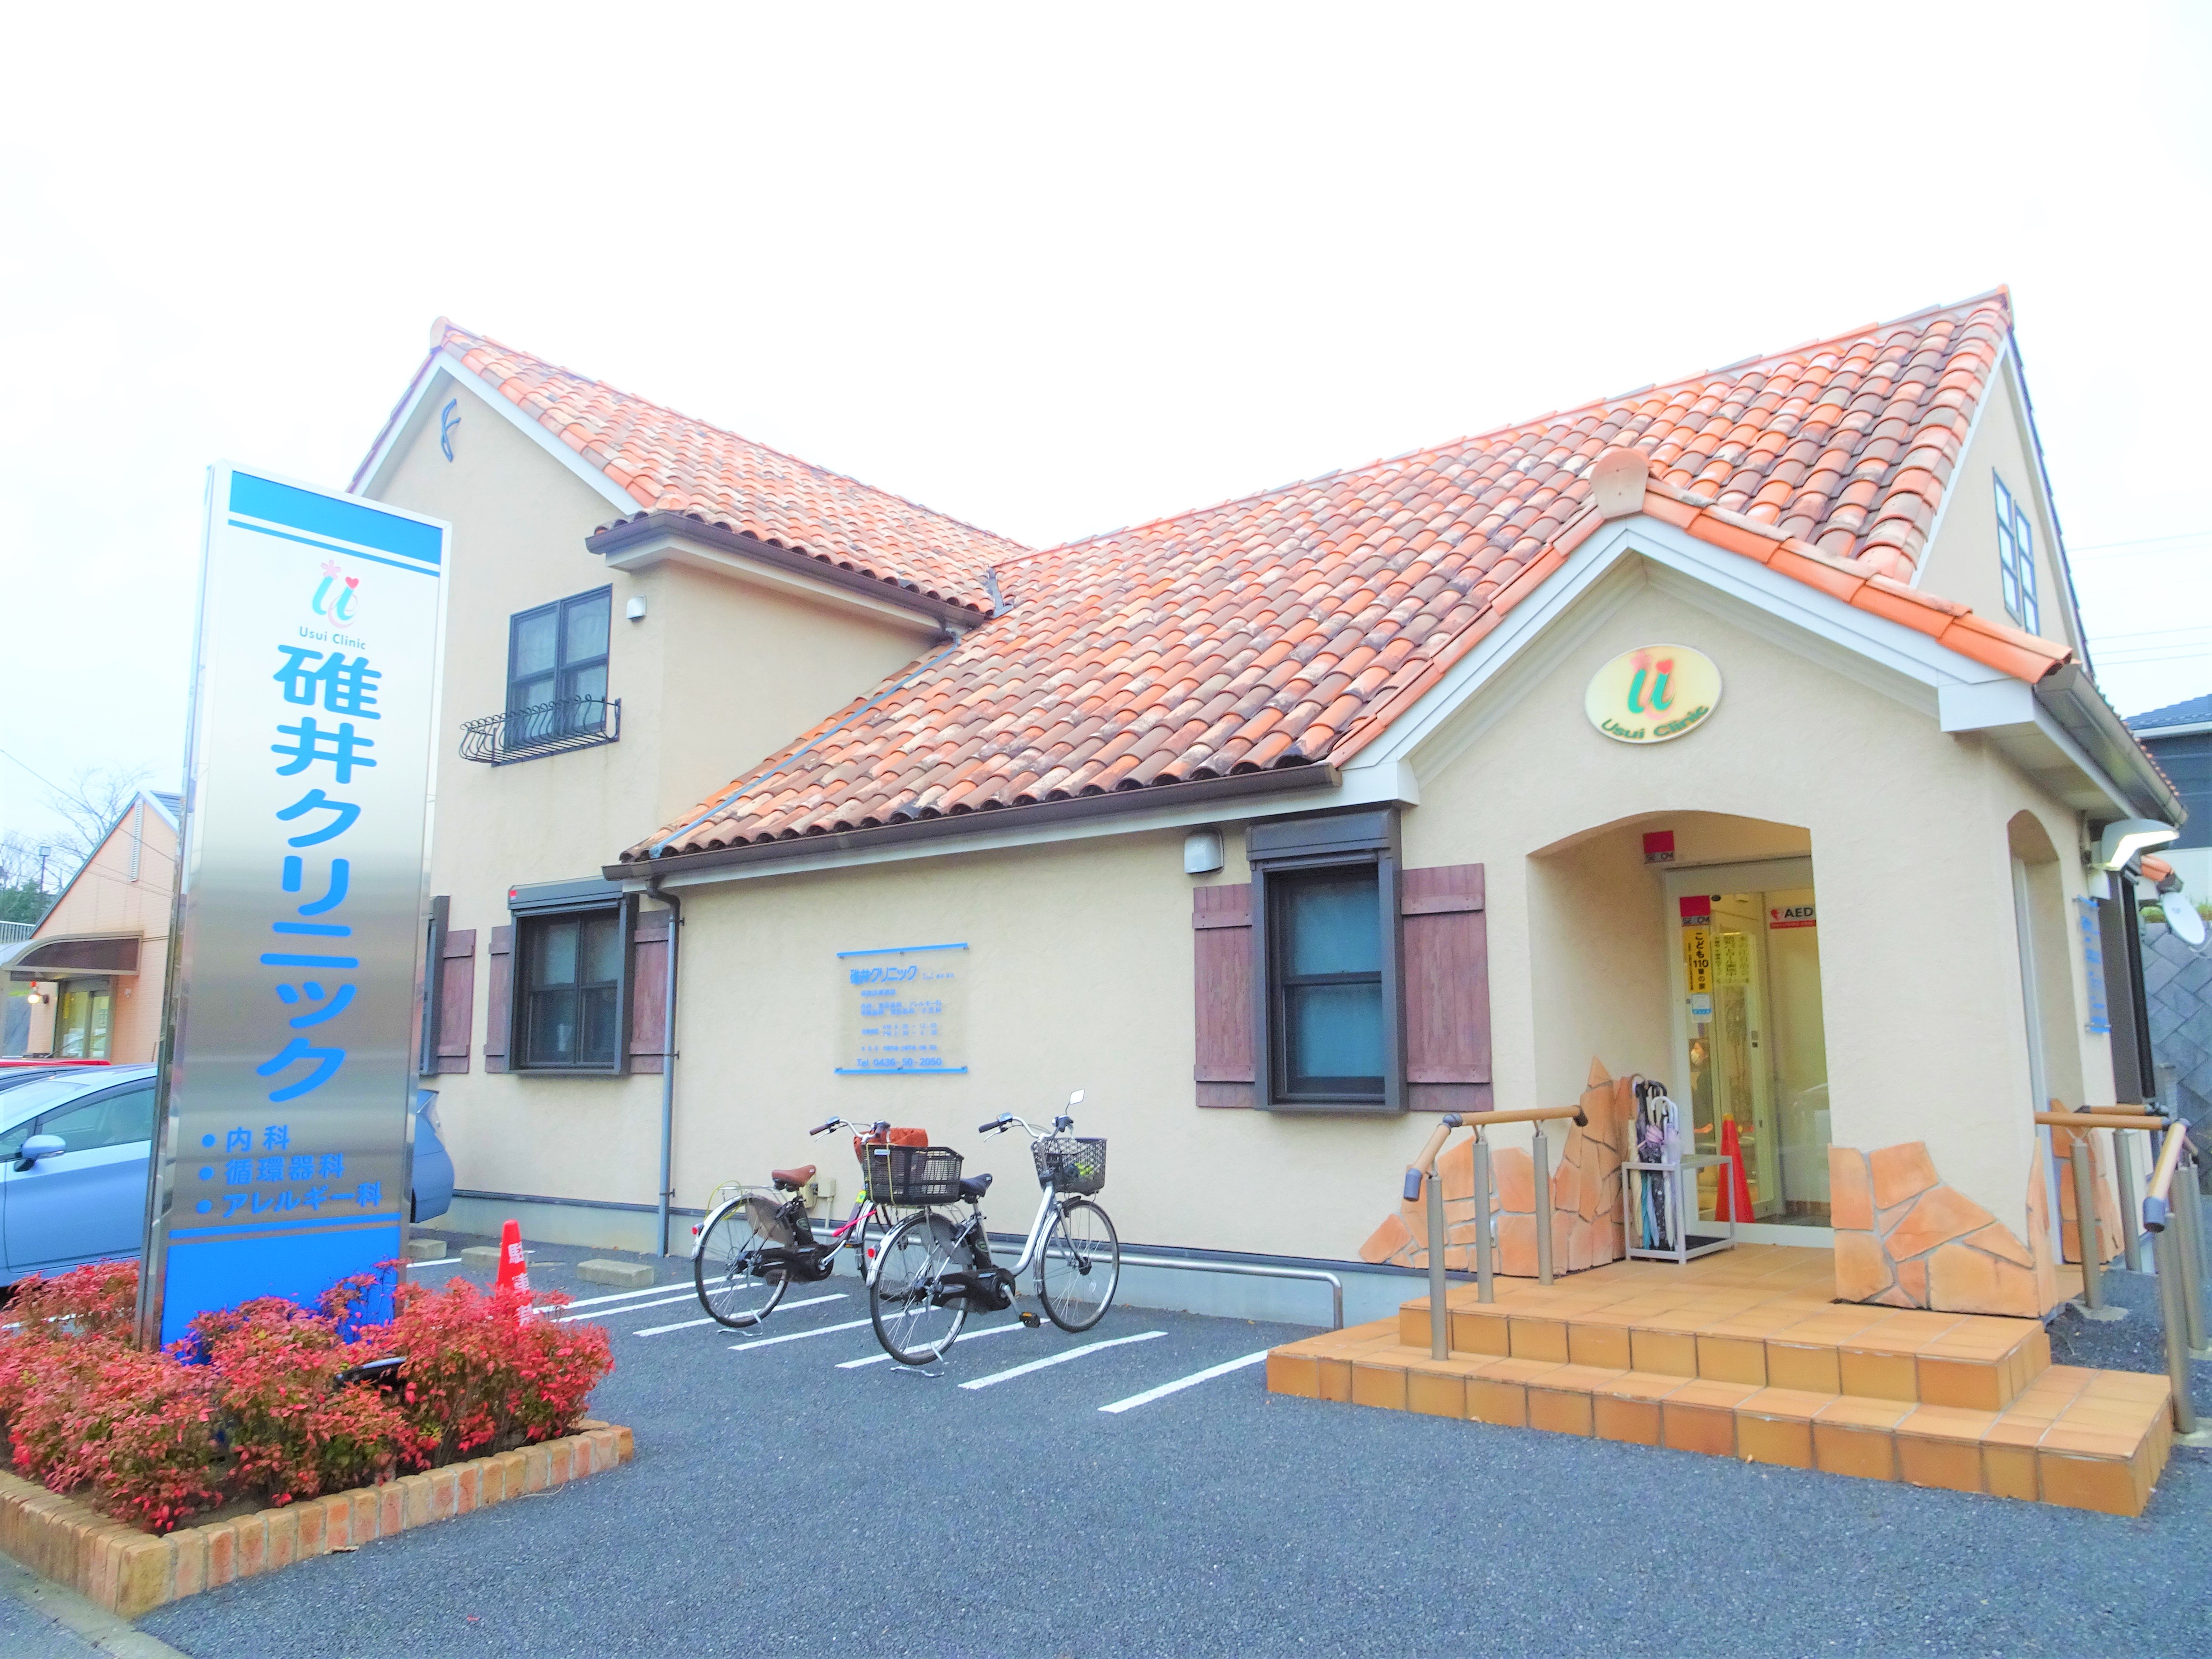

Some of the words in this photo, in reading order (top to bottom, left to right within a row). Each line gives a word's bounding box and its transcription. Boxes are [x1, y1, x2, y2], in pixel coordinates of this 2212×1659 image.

[299, 626, 328, 642] Usui
[333, 633, 366, 650] Clinic
[1601, 718, 1645, 739] Usui
[1653, 705, 1709, 737] Clinic
[1646, 851, 1673, 862] SEOM
[257, 643, 382, 1102] 碓井クリニック
[1682, 916, 1710, 926] SEOM
[1784, 907, 1814, 918] AED
[226, 1125, 290, 1152] 内科
[225, 1153, 345, 1185] 循環器科
[222, 1181, 383, 1218] アレルギー科
